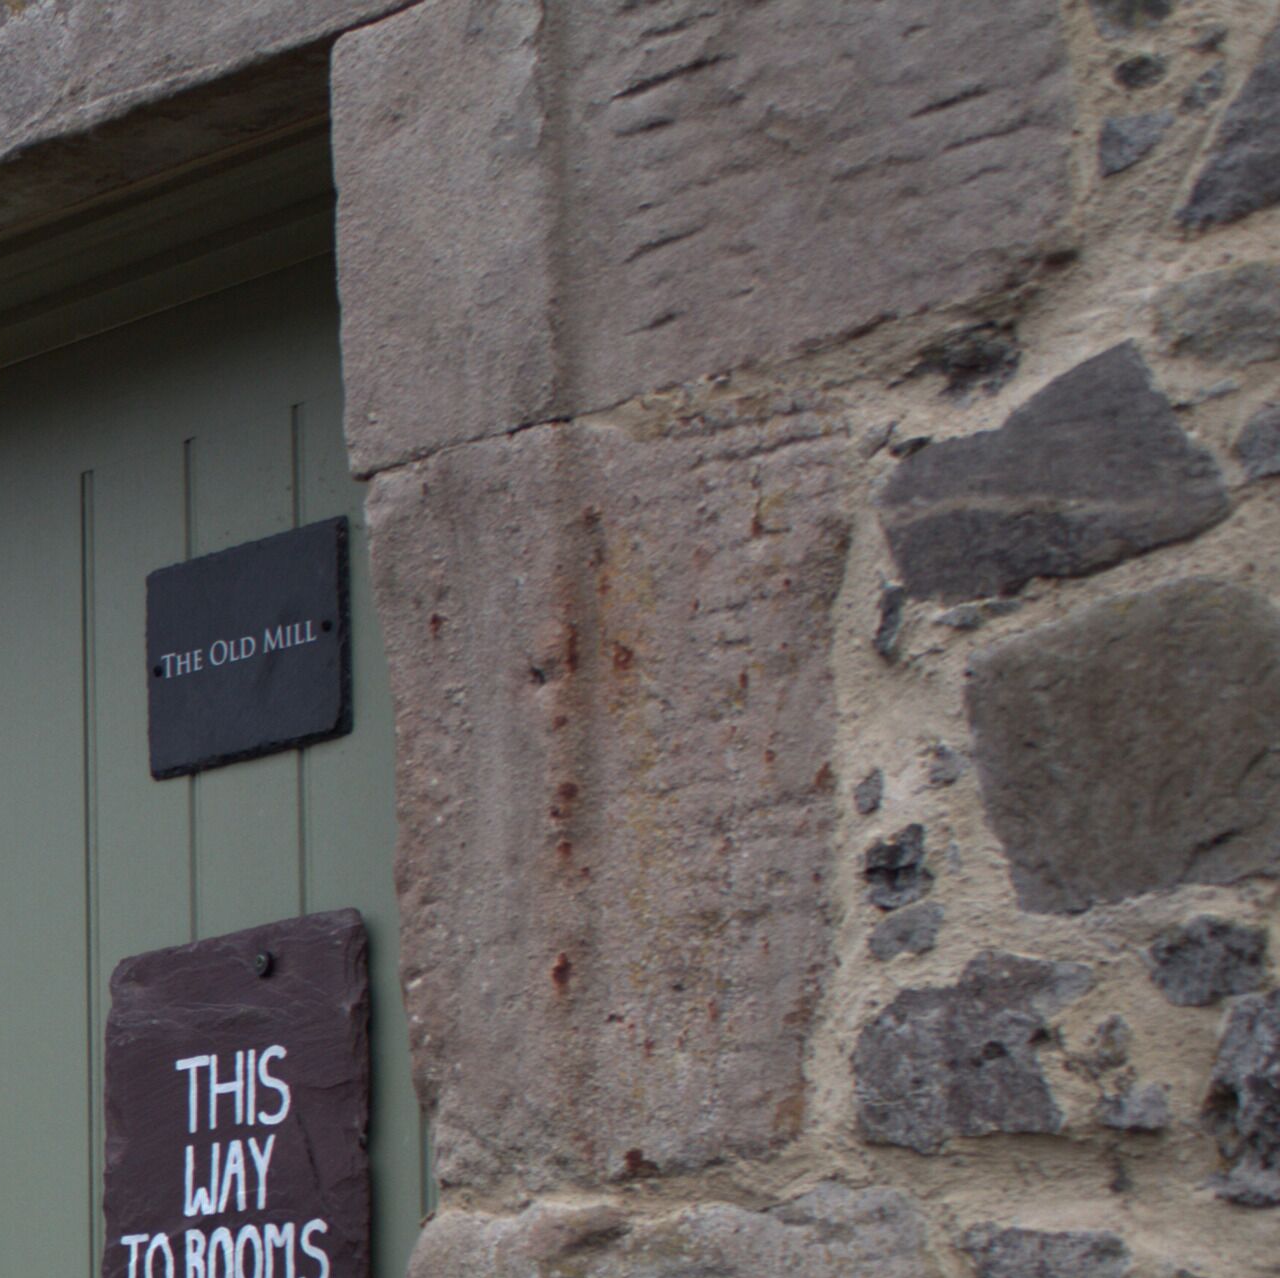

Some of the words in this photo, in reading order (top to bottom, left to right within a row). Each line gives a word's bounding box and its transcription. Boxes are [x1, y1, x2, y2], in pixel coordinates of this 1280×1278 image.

[160, 648, 203, 679] THE
[209, 635, 256, 667] OLD
[262, 619, 317, 654] MILL
[175, 1044, 291, 1134] THIS
[183, 1133, 276, 1218] WAY
